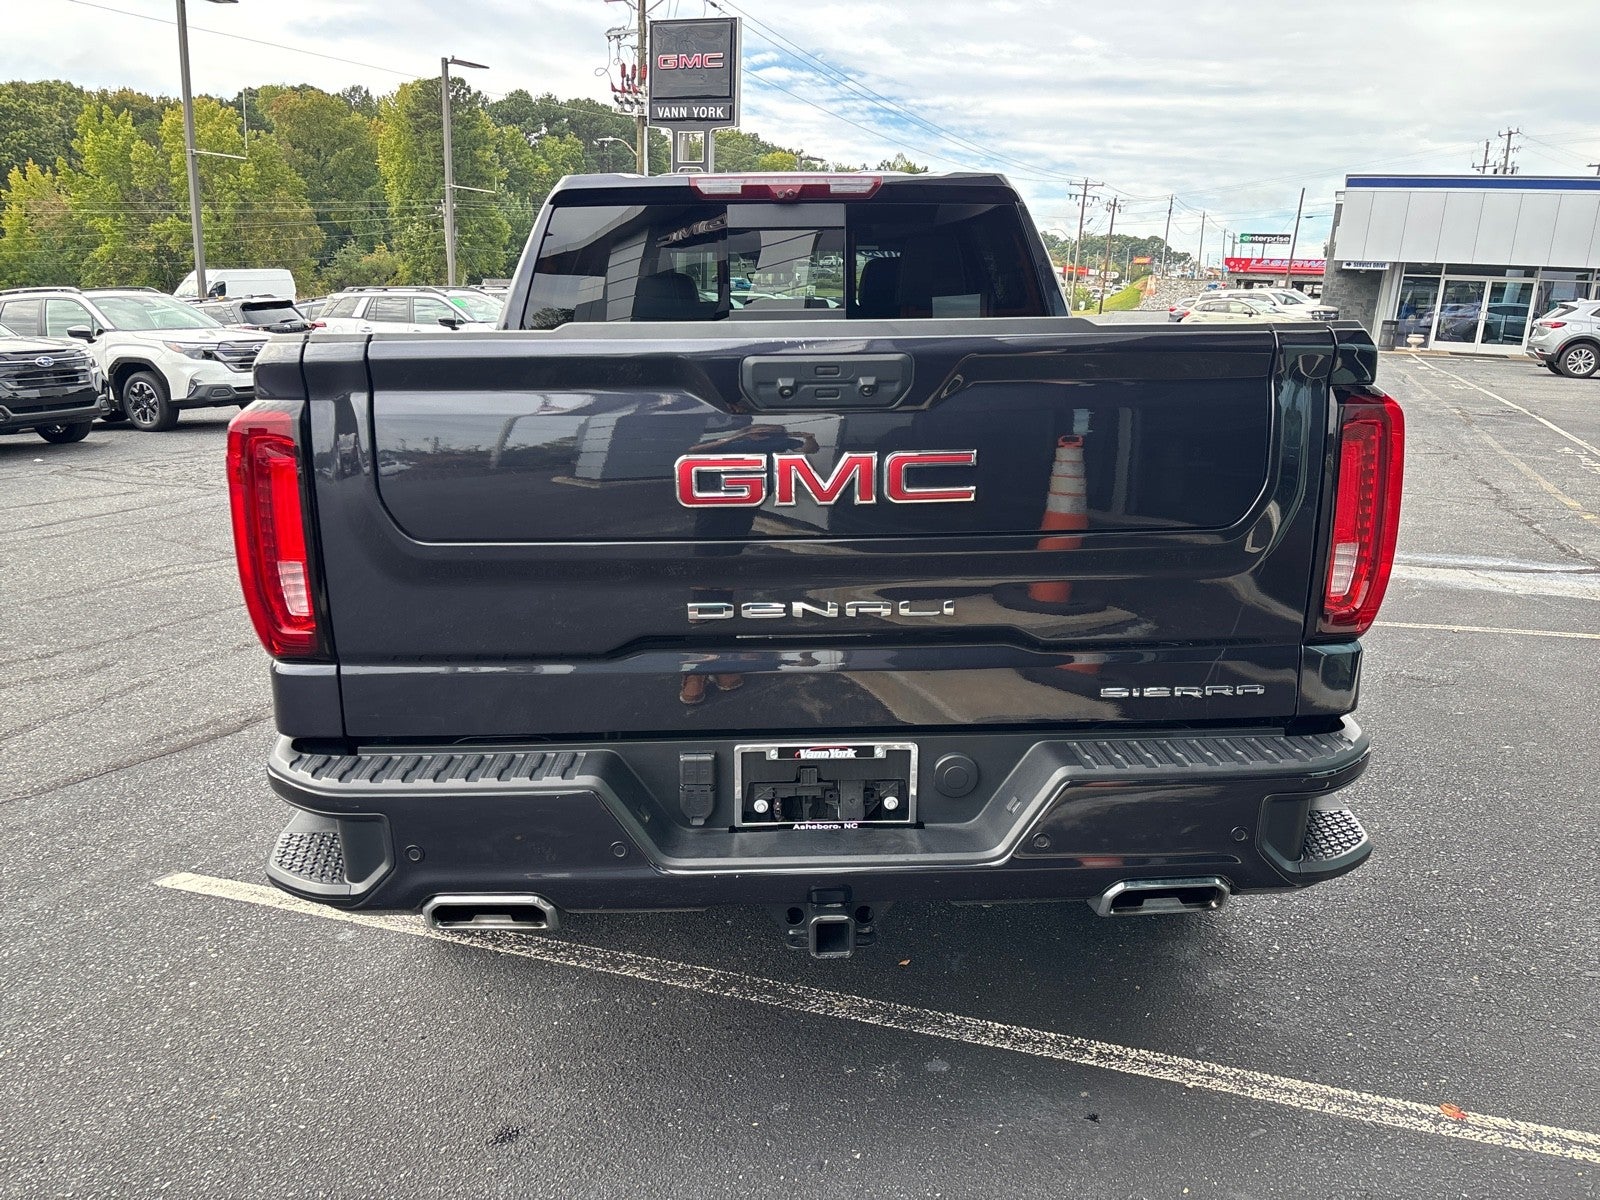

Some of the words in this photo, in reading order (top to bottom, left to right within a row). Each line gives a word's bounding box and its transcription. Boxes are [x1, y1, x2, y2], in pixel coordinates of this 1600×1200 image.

[657, 53, 724, 70] GMC
[658, 107, 687, 118] VANN
[693, 106, 724, 118] YORK
[674, 449, 978, 508] GMC
[687, 600, 955, 622] DENALI
[1100, 684, 1266, 698] SIERRA
[799, 748, 830, 759] Vann
[828, 748, 857, 759] York
[844, 822, 858, 830] NC
